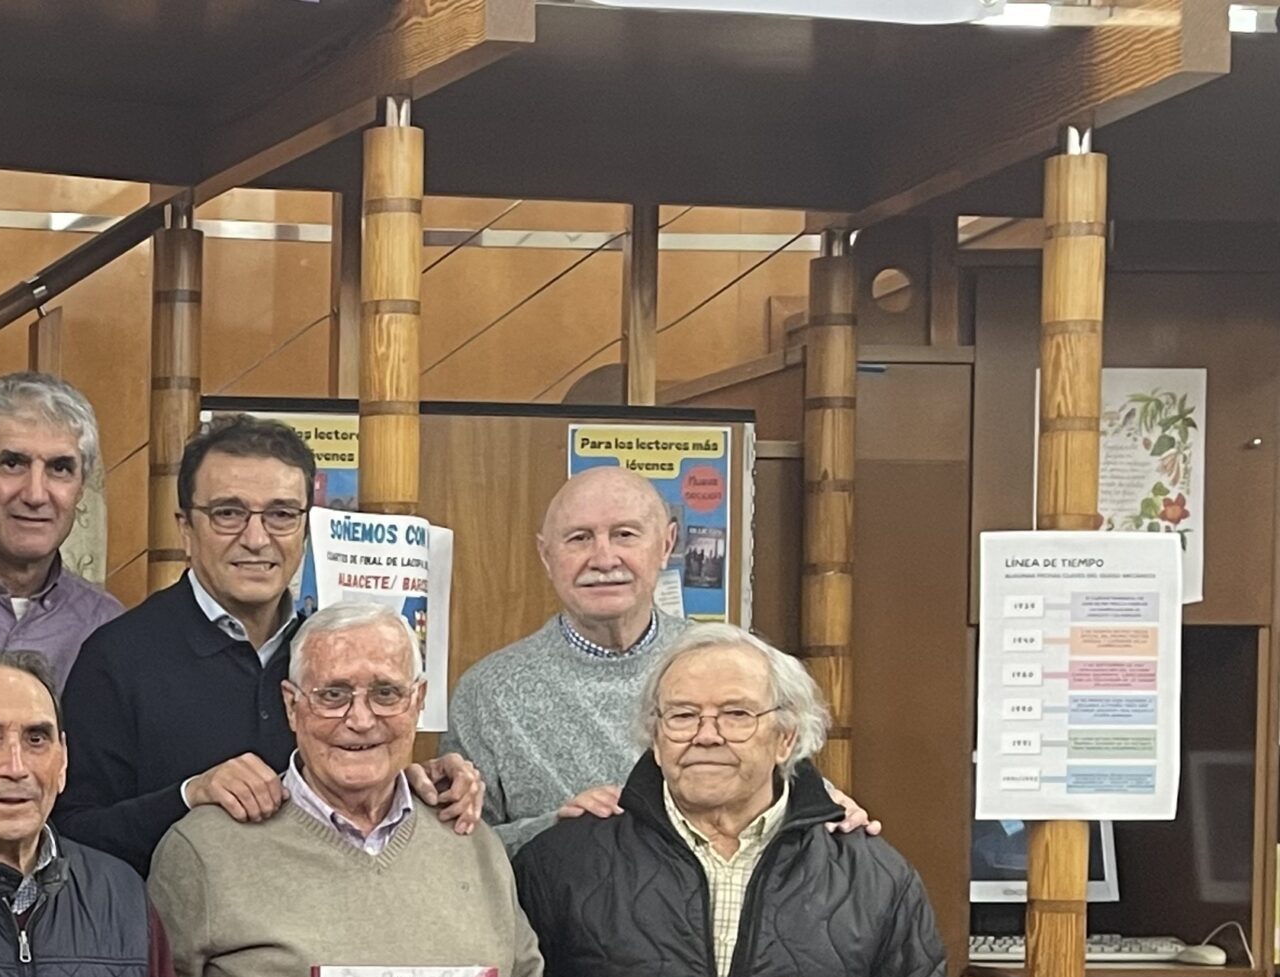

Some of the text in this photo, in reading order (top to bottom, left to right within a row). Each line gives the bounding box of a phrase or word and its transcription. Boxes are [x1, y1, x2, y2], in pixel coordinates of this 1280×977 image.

[580, 438, 718, 451] Para los lectores más
[626, 459, 674, 471] jóvenes
[331, 515, 398, 544] SOÑEMOS
[360, 556, 383, 565] FINAL
[387, 557, 397, 566] DE
[1005, 556, 1104, 568] LÍNEA DE TIEMPO
